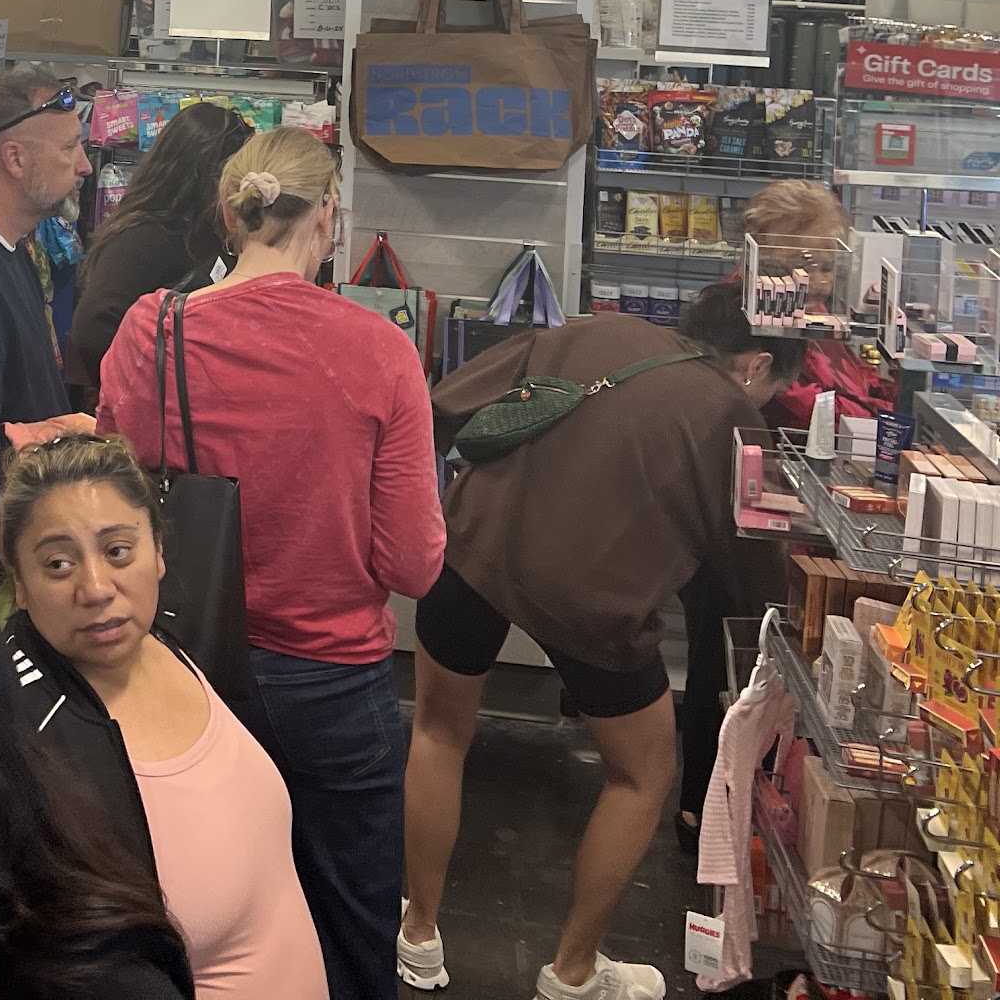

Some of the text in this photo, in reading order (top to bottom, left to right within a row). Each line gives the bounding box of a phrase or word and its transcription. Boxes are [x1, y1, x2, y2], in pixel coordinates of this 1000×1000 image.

[864, 54, 993, 83] Gift Cards
[862, 74, 992, 96] Give the gift of shopping.
[105, 115, 131, 128] SMART
[106, 121, 135, 137] SWEETS
[662, 125, 700, 140] PANDA
[721, 135, 746, 146] SEA SALT
[719, 145, 744, 155] CARAMEL
[689, 922, 721, 939] HUGGIES
